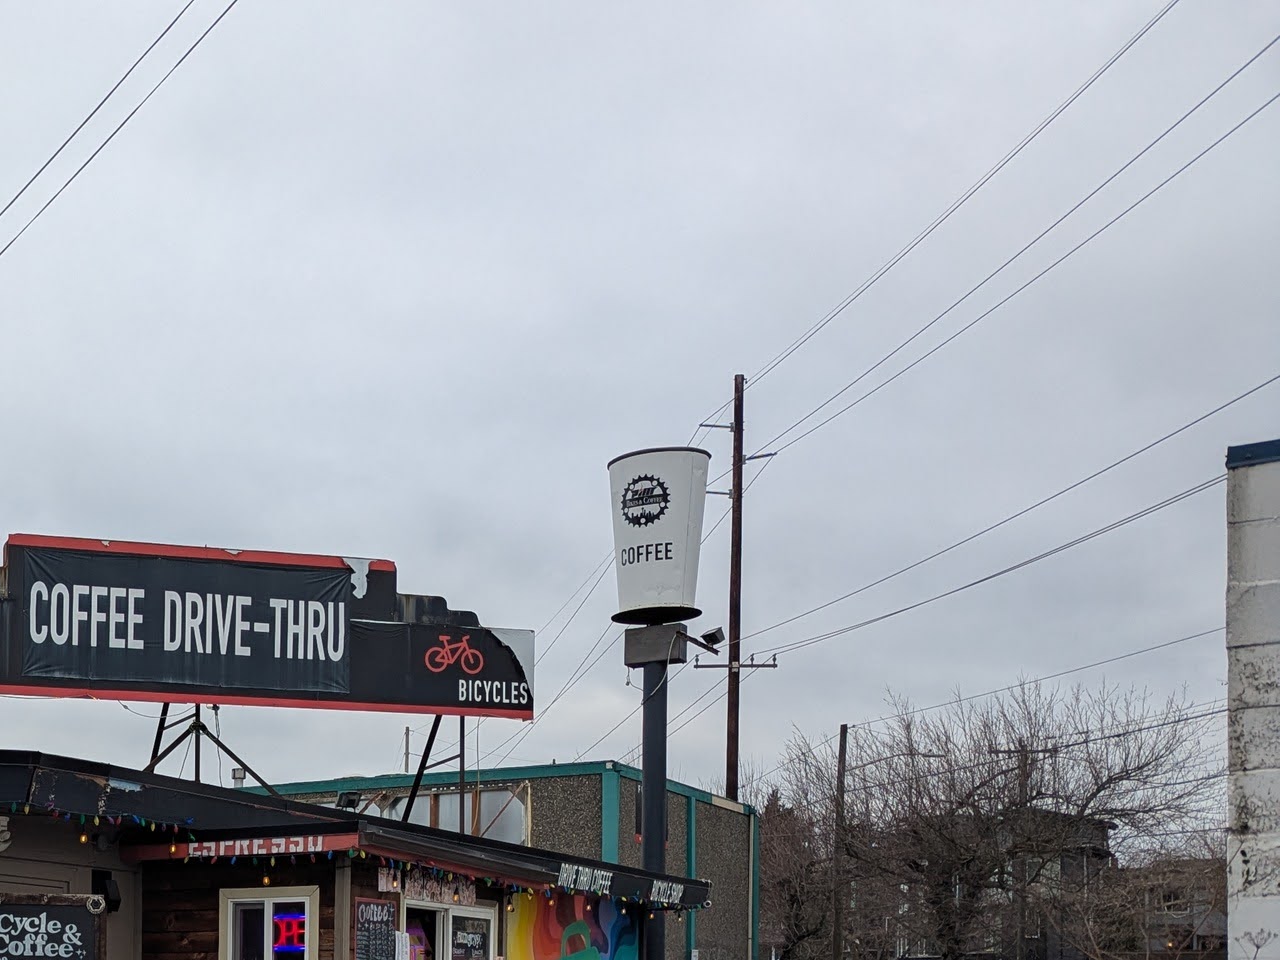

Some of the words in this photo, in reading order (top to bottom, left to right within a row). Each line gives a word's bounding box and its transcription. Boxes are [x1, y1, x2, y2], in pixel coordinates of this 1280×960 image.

[621, 542, 673, 566] COFFEE
[29, 581, 145, 650] COFFEE
[163, 590, 345, 662] DRIVE-THRU
[458, 679, 528, 704] BICYCLES
[62, 924, 82, 946] &
